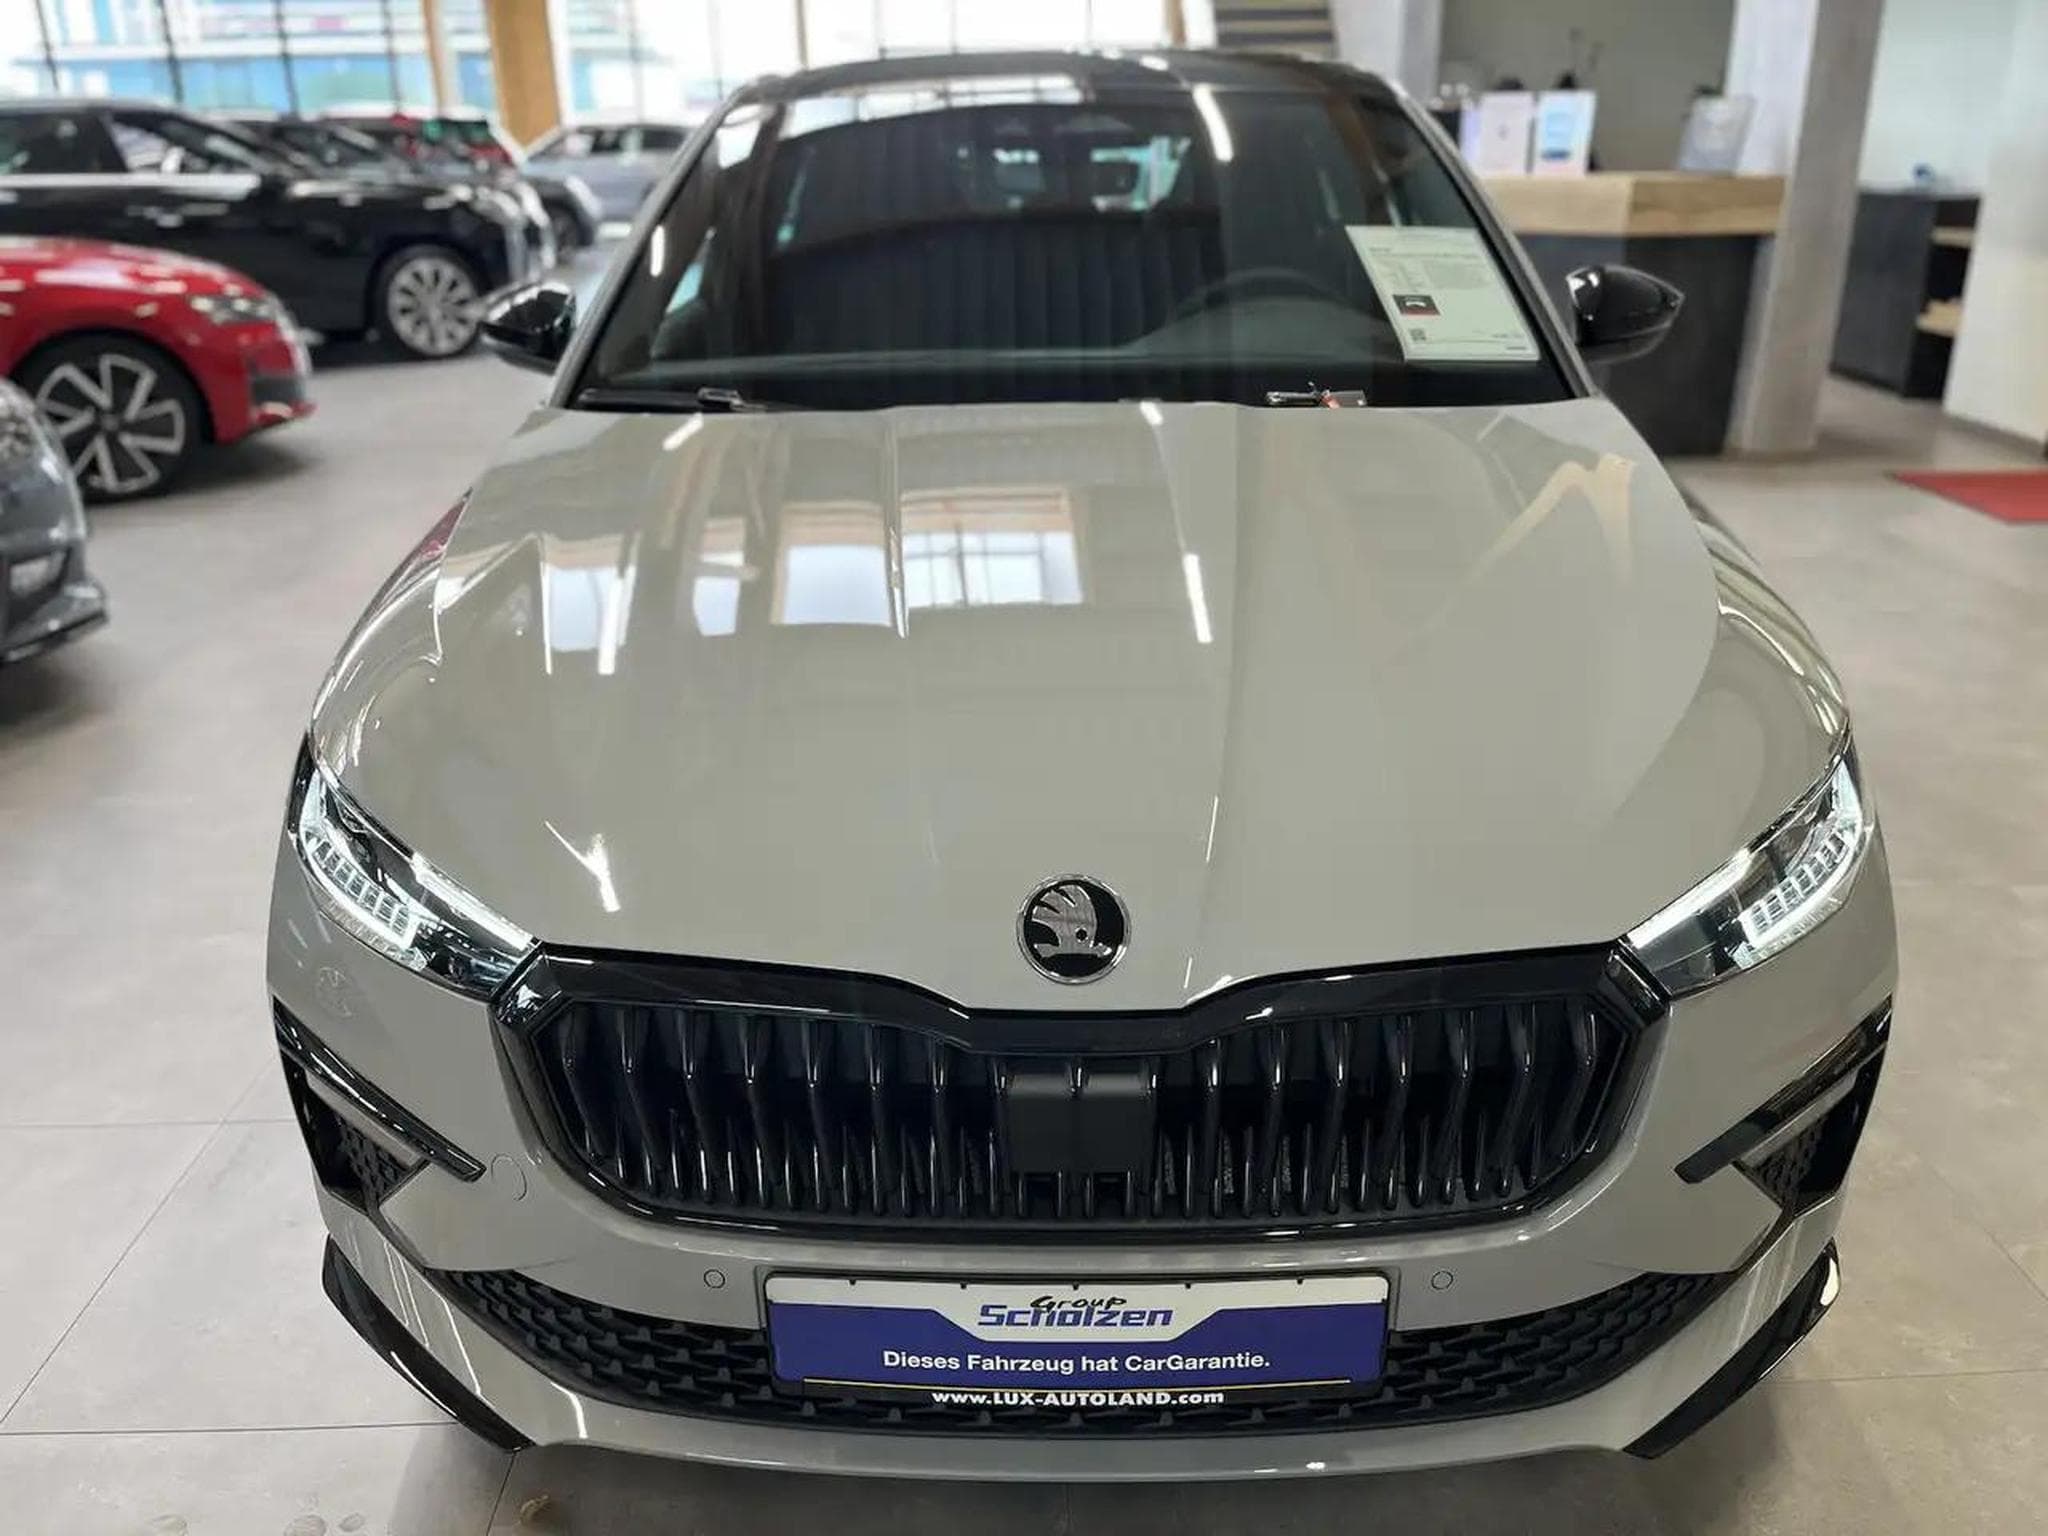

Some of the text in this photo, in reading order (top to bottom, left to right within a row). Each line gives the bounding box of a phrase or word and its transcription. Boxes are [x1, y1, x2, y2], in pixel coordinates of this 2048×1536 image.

[1030, 1295, 1127, 1314] Group
[978, 1304, 1174, 1327] Scholzen
[883, 1350, 1270, 1375] Dieses Fahrzeug hat CarGarantie.
[932, 1391, 1224, 1406] www.LUX-AUTOLAND.com
